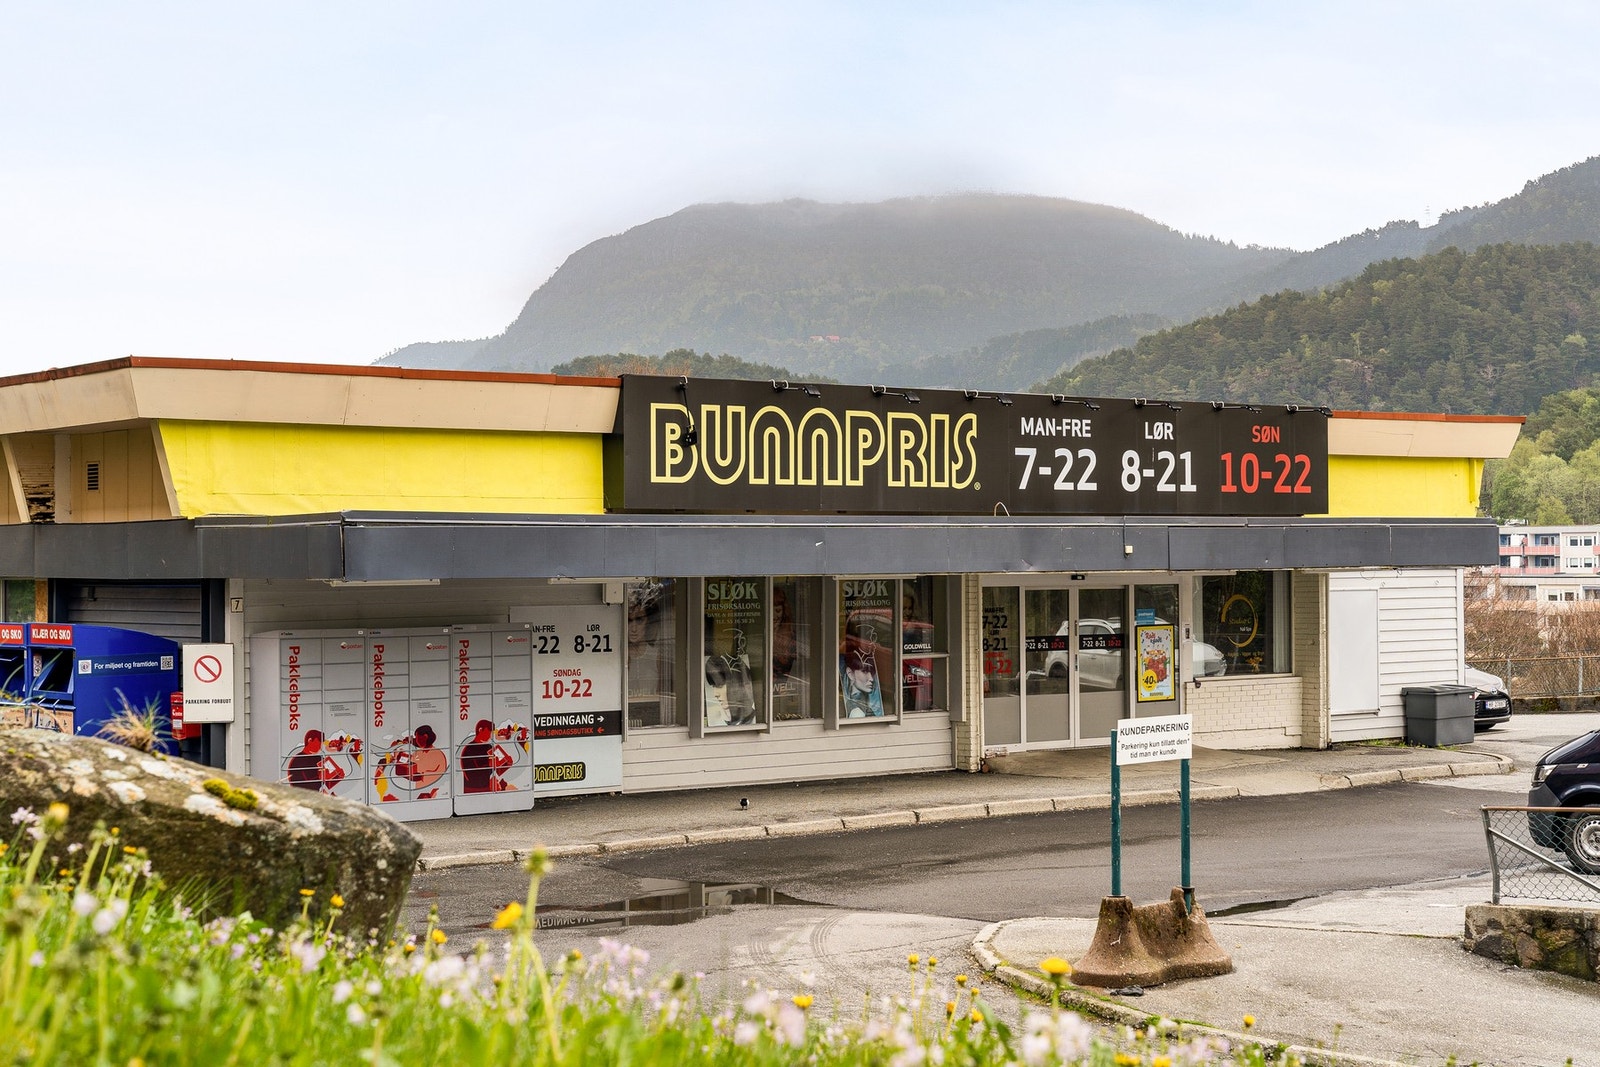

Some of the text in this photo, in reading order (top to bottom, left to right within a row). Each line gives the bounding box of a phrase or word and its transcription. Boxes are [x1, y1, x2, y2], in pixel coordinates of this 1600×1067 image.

[1020, 416, 1280, 443] MAN-FRE LØR SØN
[650, 402, 977, 490] BUNNPRIS
[1014, 447, 1312, 494] 7-22 8-21 10-22
[708, 581, 759, 601] SLØK
[842, 579, 889, 599] SLØK
[235, 600, 240, 610] 7
[707, 602, 760, 610] FRISØRSALONG
[982, 615, 1008, 628] 7-22
[1, 629, 22, 639] OG SKO
[32, 628, 71, 640] KLÆR OG SKO
[574, 634, 612, 653] 8-21
[983, 638, 1008, 651] 8-21
[105, 662, 123, 670] miljøet
[553, 669, 581, 677] SØNDAG
[373, 644, 385, 728] Pakkeboks
[458, 639, 470, 721] Pakkeboks
[289, 645, 301, 731] Pakkeboks
[542, 678, 593, 699] 10-22
[547, 727, 594, 736] SØNDAGSBUTIKK
[1119, 722, 1189, 736] KUNDEPARKERING
[1121, 742, 1148, 751] Parkering
[1161, 739, 1176, 747] tillatt
[1176, 738, 1188, 746] den
[1130, 751, 1138, 759] tid
[1159, 748, 1177, 756] kunde
